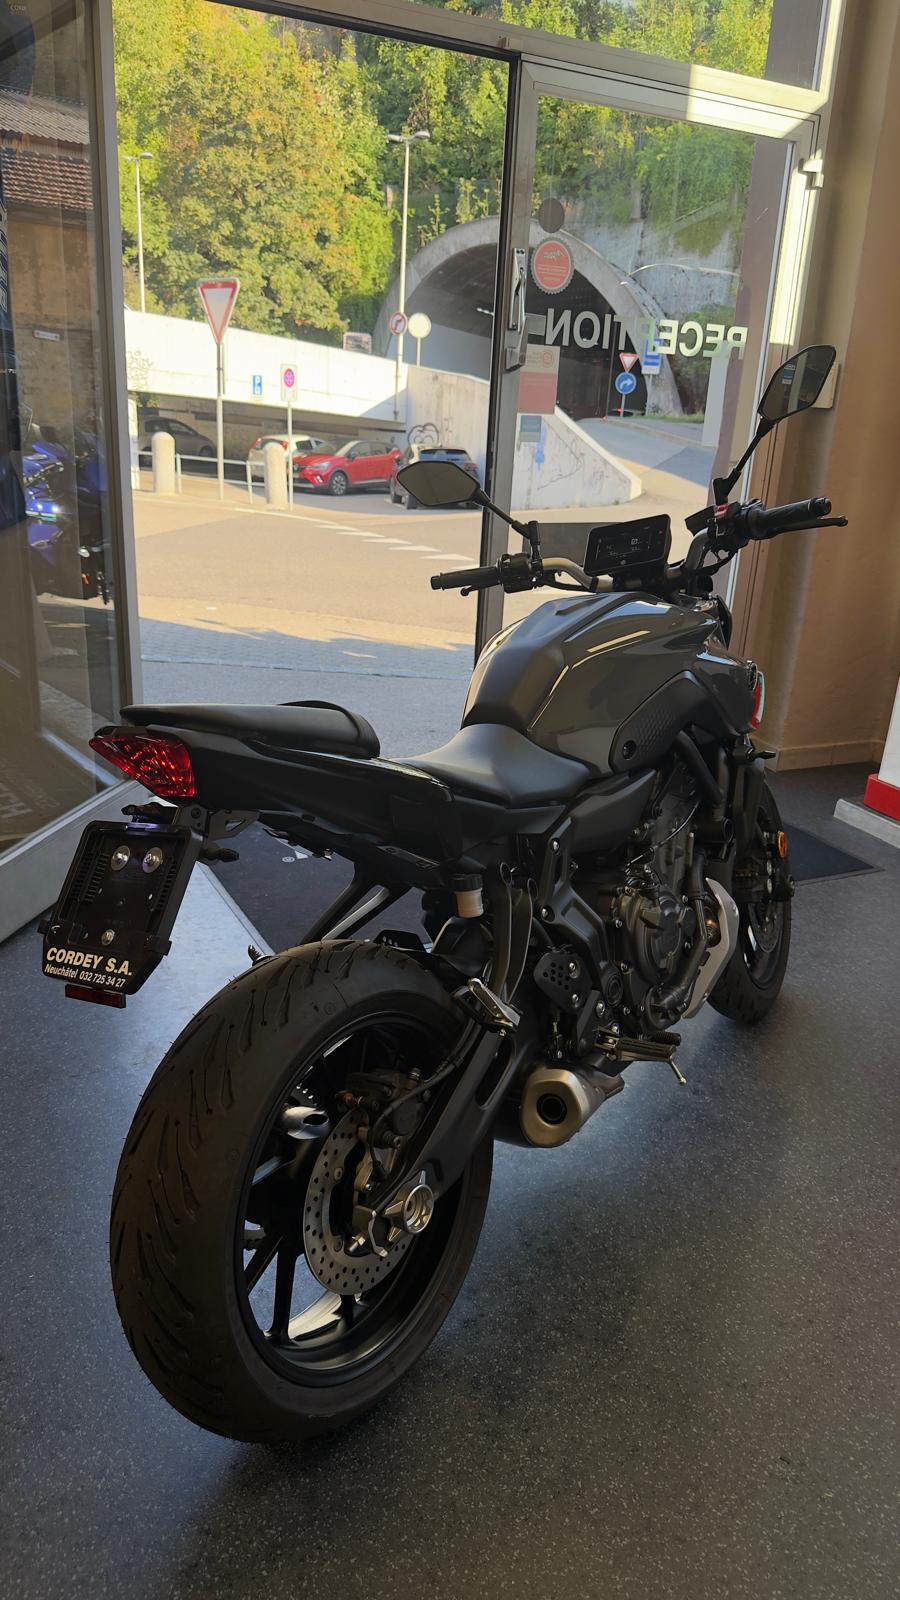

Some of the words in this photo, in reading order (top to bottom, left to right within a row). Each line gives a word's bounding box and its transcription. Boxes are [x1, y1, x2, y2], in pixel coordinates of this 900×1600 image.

[46, 947, 103, 969] CORDEY
[105, 957, 132, 976] S.A.
[44, 963, 79, 978] Neuchâtel
[79, 970, 93, 981] 032
[92, 973, 106, 985] 725
[105, 976, 116, 986] 34
[115, 978, 126, 988] 27
